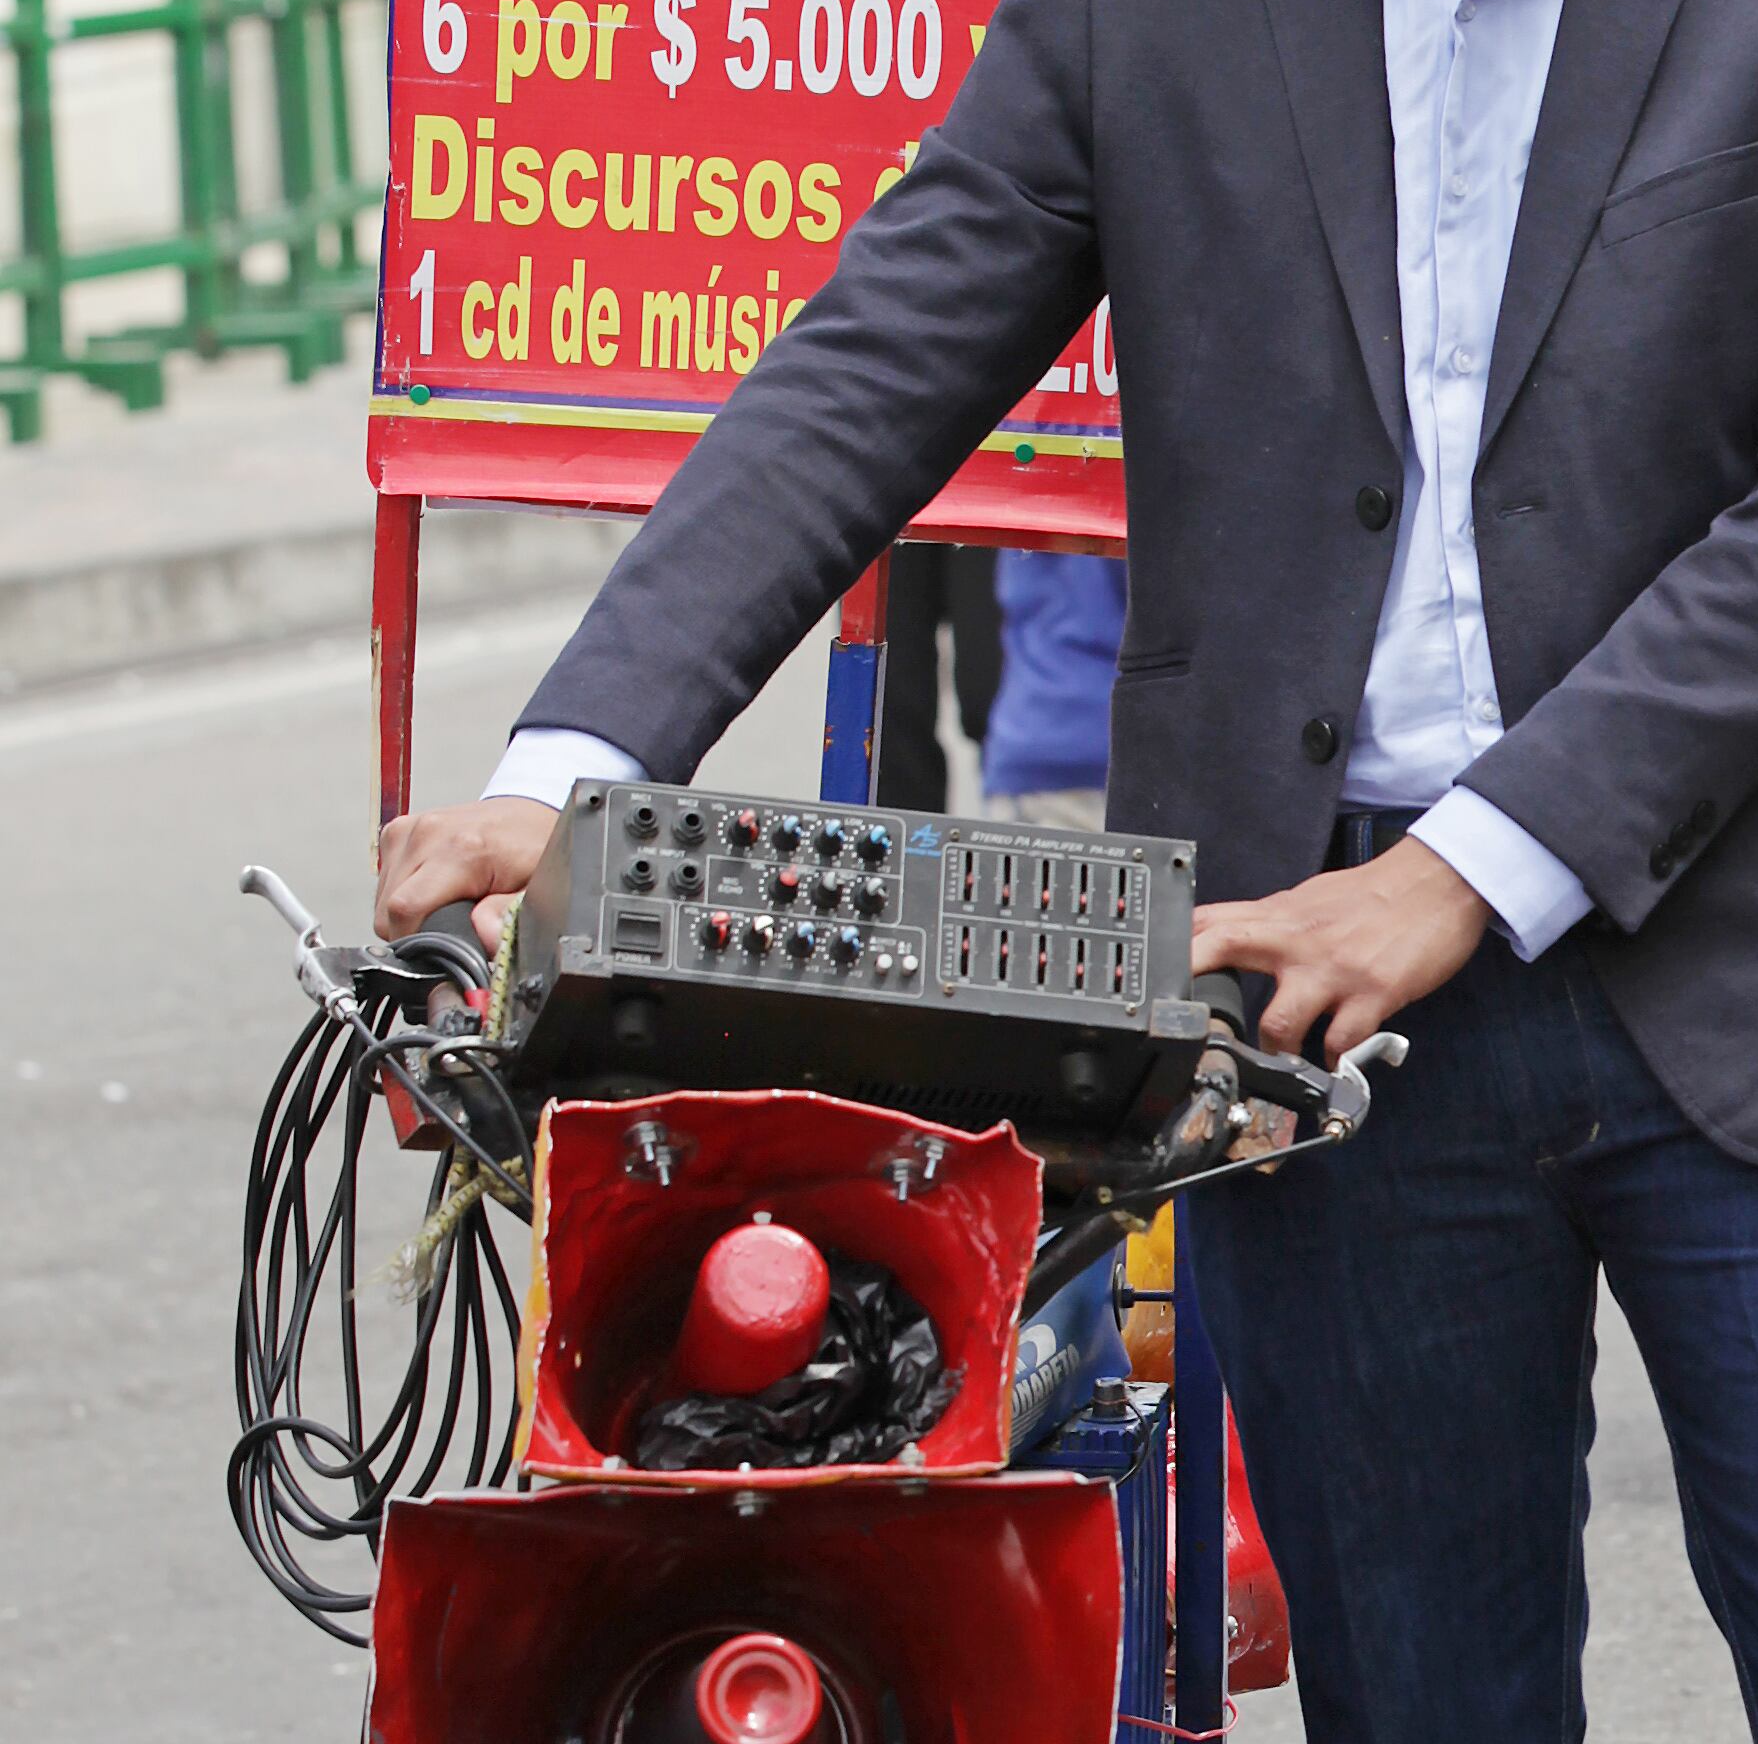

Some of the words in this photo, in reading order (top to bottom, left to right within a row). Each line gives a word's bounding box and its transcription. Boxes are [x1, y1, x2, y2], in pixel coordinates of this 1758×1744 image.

[411, 114, 843, 244] Discursos
[409, 249, 436, 356] 1
[461, 255, 532, 362] cd
[550, 258, 621, 367] de
